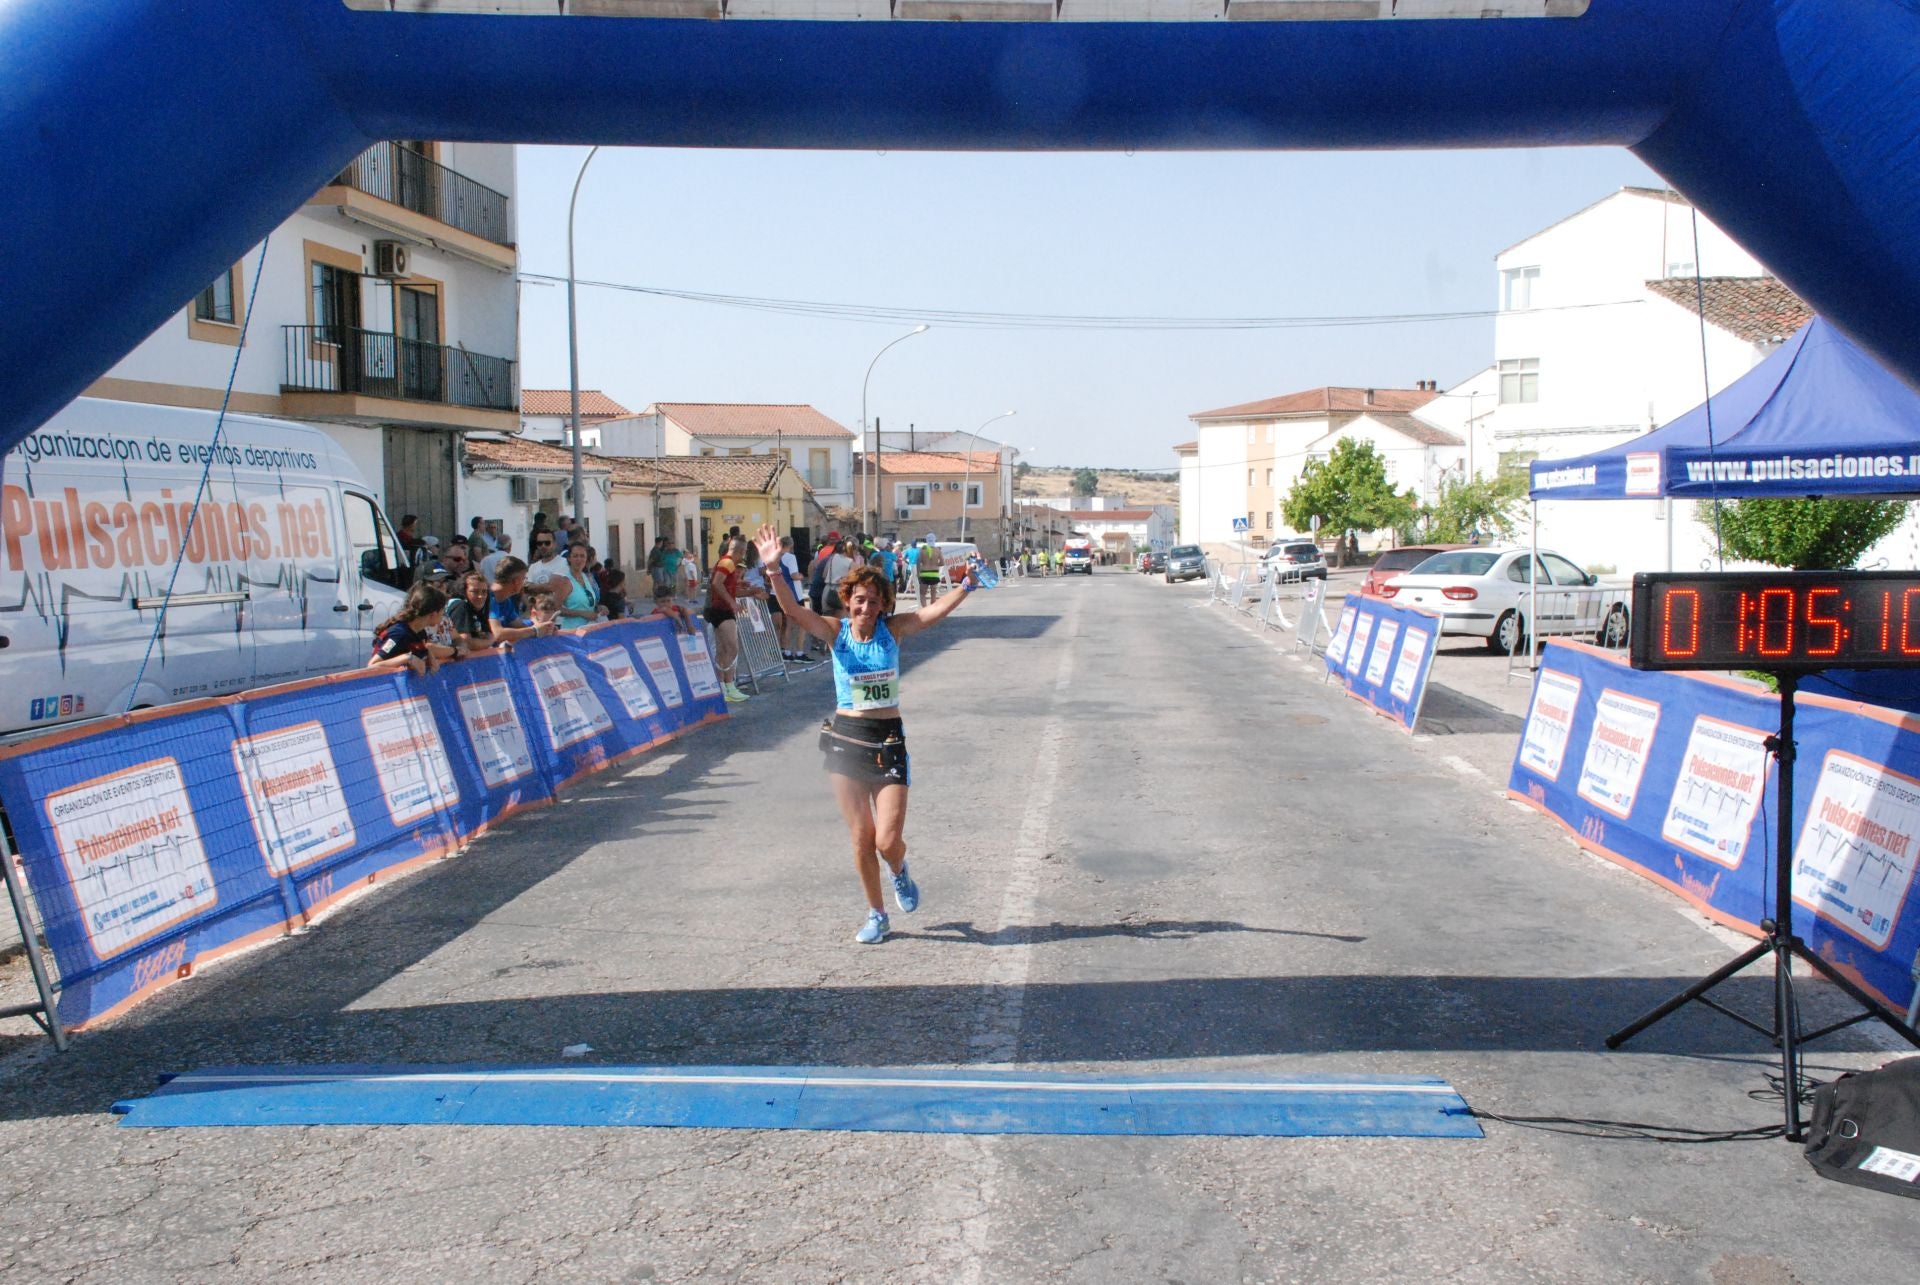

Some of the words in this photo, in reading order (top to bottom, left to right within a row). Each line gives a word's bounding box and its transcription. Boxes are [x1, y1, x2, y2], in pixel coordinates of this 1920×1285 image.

[9, 430, 142, 463] ganizacion
[147, 435, 171, 462] de
[179, 441, 241, 465] eventos
[245, 443, 316, 471] deportivos
[3, 484, 332, 571] Pulsaciones.net
[862, 683, 890, 701] 205
[103, 789, 113, 801] DE
[113, 781, 141, 797] EVENTOS
[75, 805, 183, 865] Pulsaciones.net
